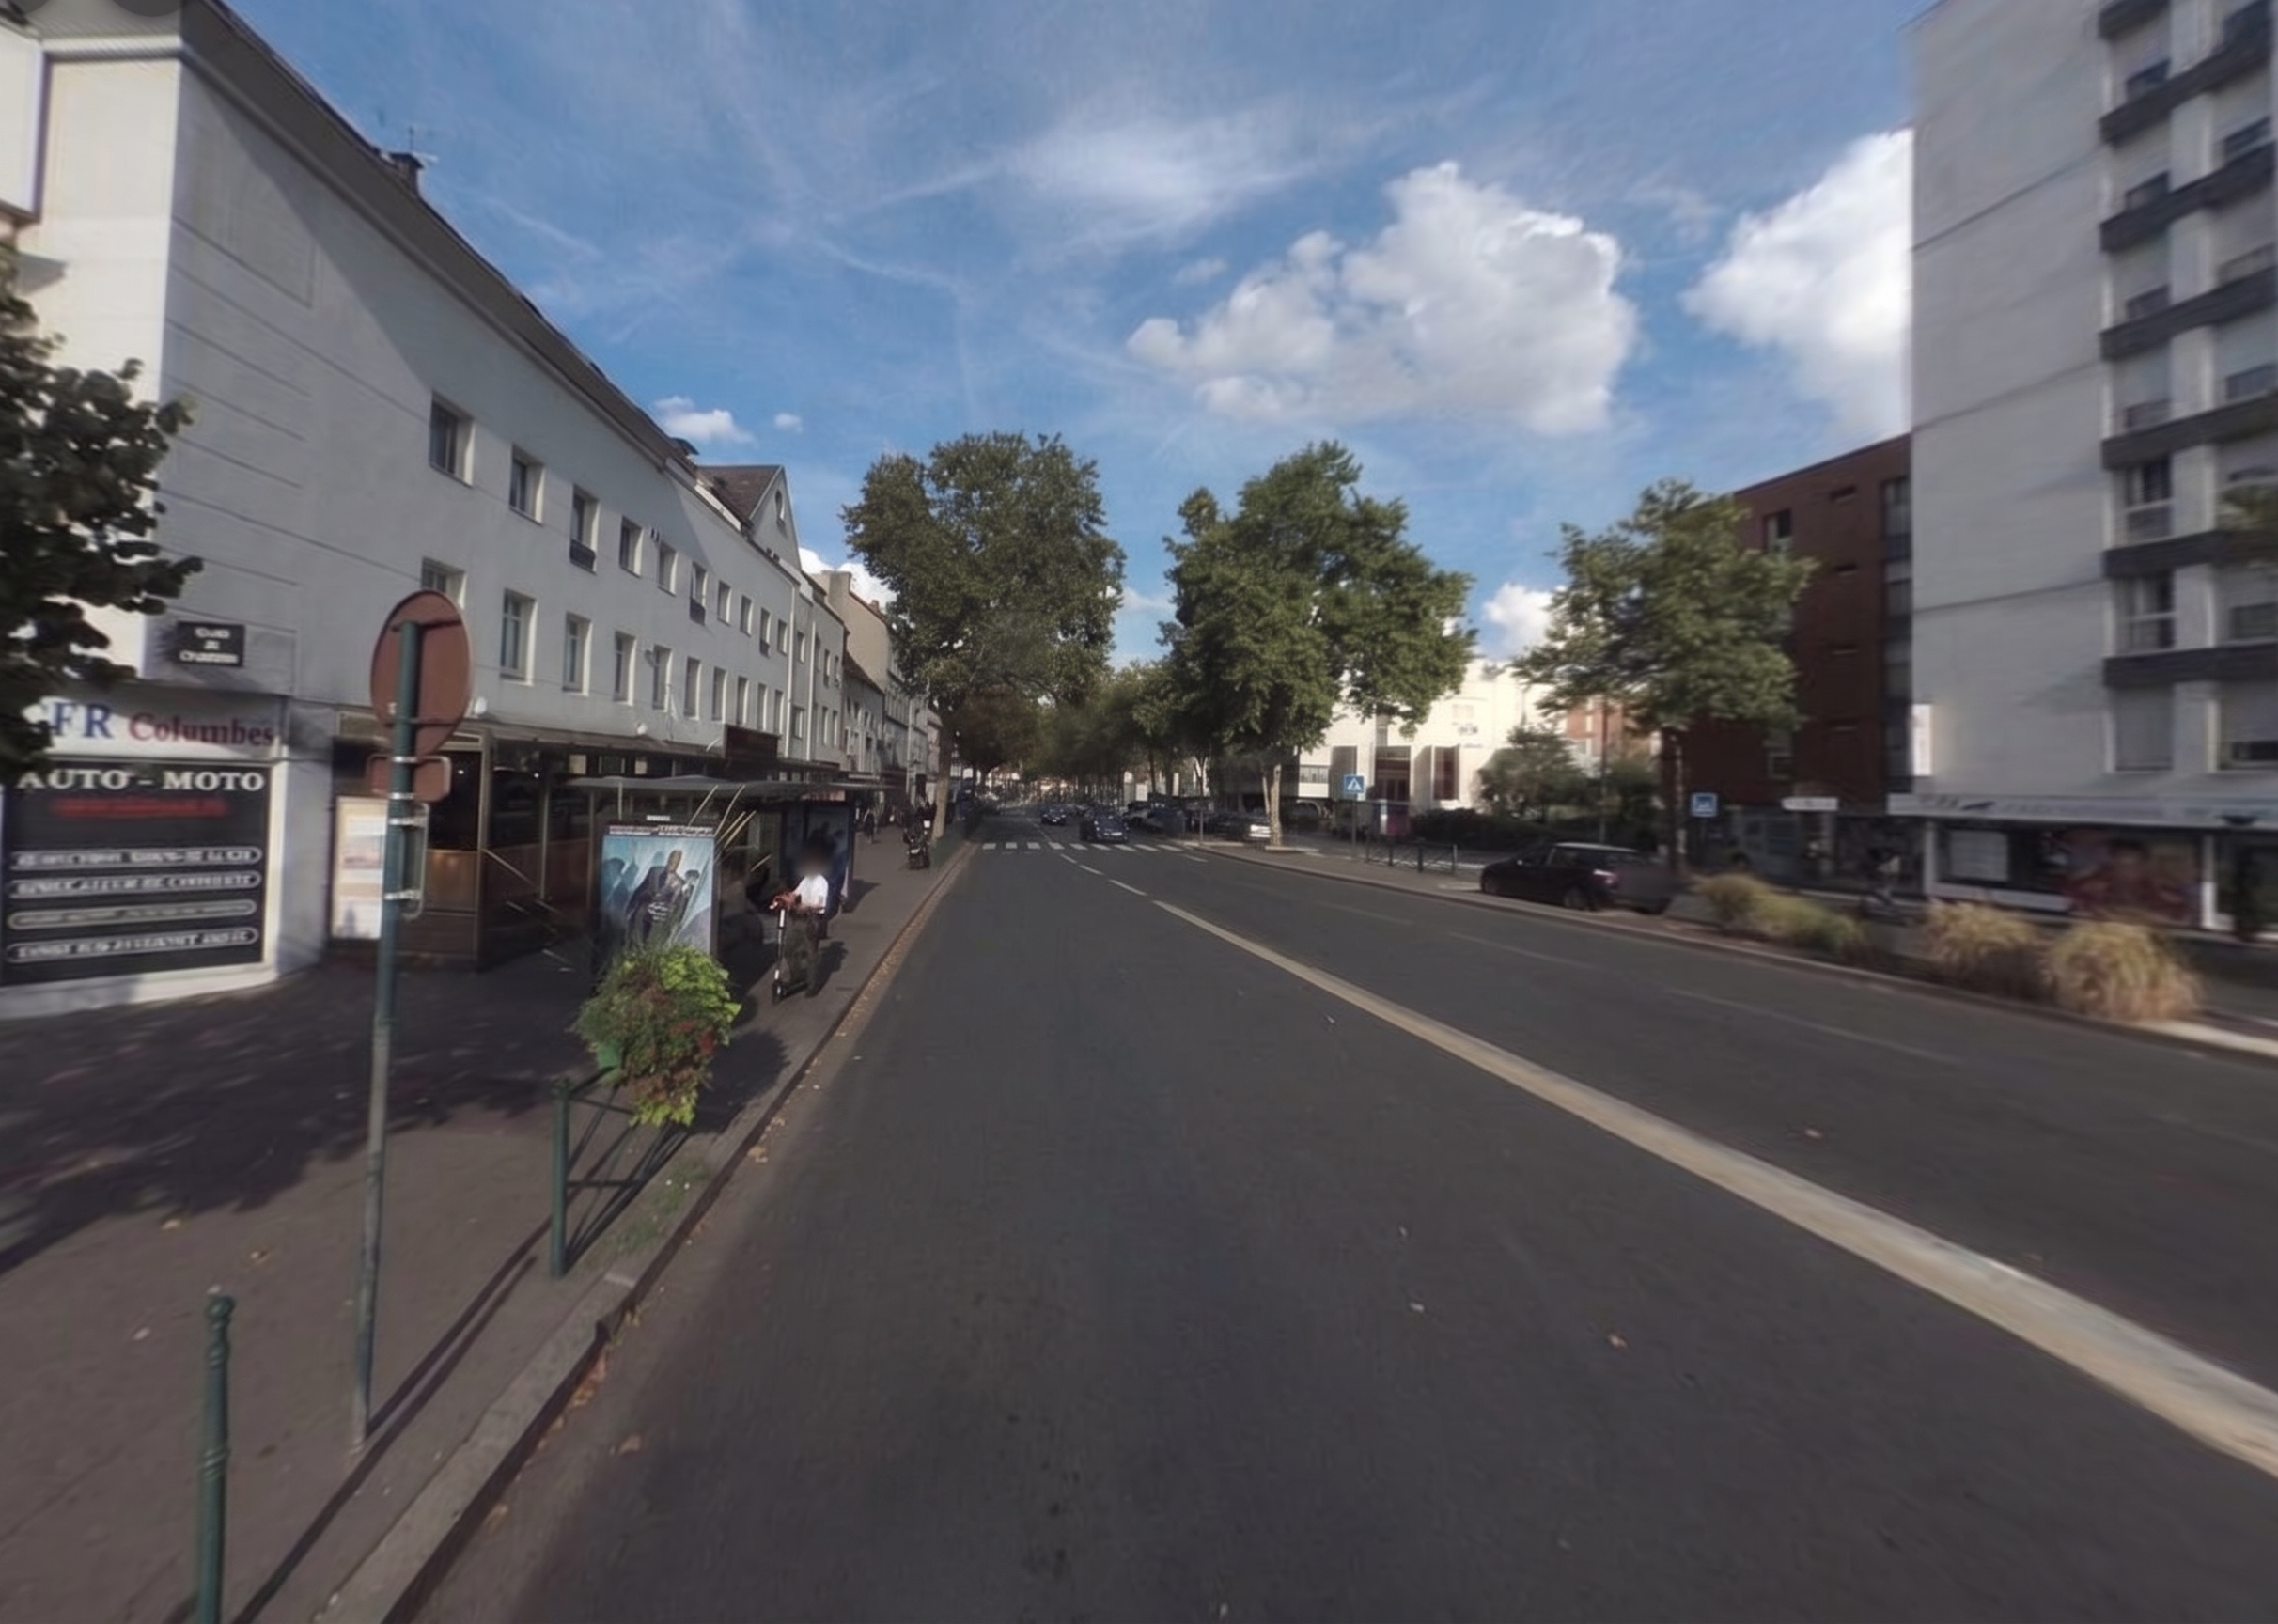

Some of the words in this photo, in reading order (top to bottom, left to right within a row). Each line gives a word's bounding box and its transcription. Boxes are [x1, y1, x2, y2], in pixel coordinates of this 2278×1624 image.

[42, 702, 114, 739] FR
[17, 769, 130, 789] AUTO
[163, 771, 265, 791] MOTO
